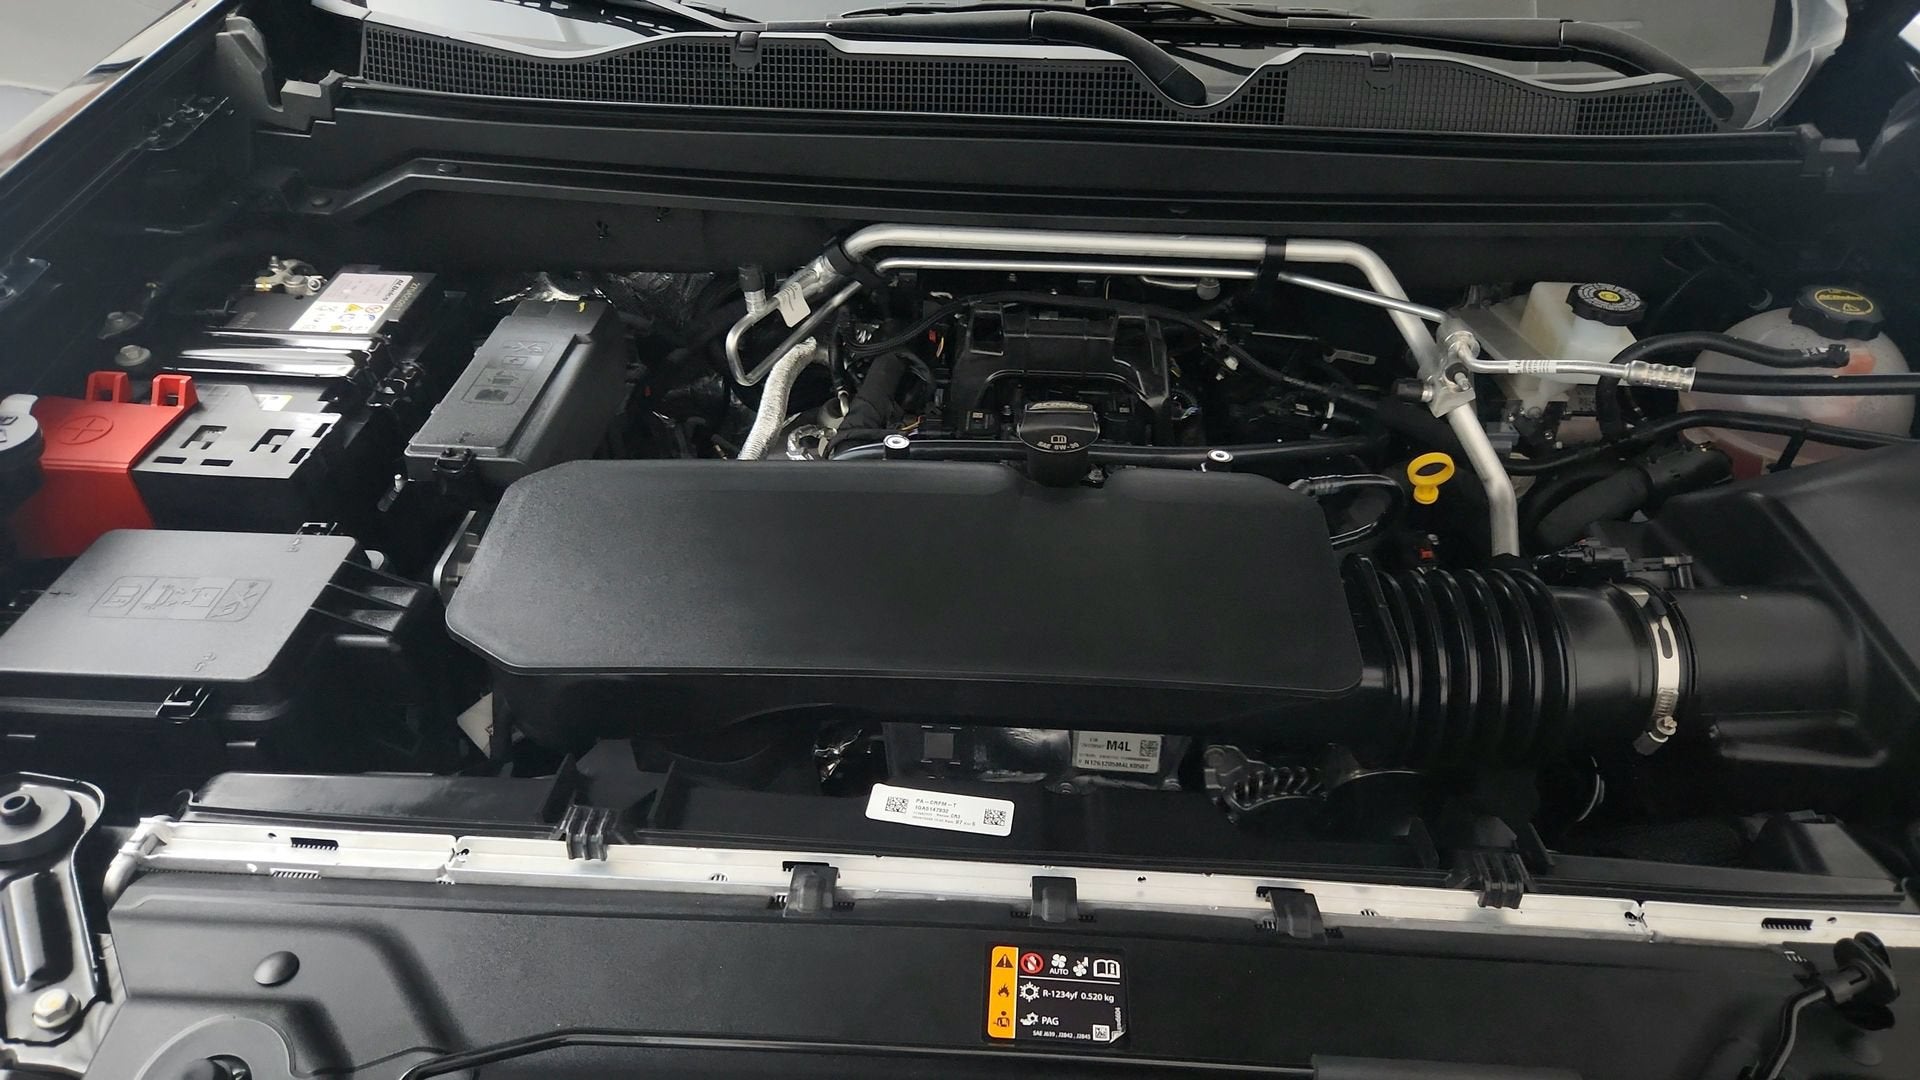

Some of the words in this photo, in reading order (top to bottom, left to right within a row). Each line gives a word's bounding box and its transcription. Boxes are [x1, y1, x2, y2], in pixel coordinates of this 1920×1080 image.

[1037, 441, 1052, 450] SAE
[1106, 740, 1132, 752] M4L
[1049, 968, 1069, 976] AUTO
[1042, 989, 1078, 1000] R-1234yf
[1081, 992, 1103, 1001] 0.520
[1104, 994, 1115, 1003] kg
[1041, 1016, 1059, 1026] PAG
